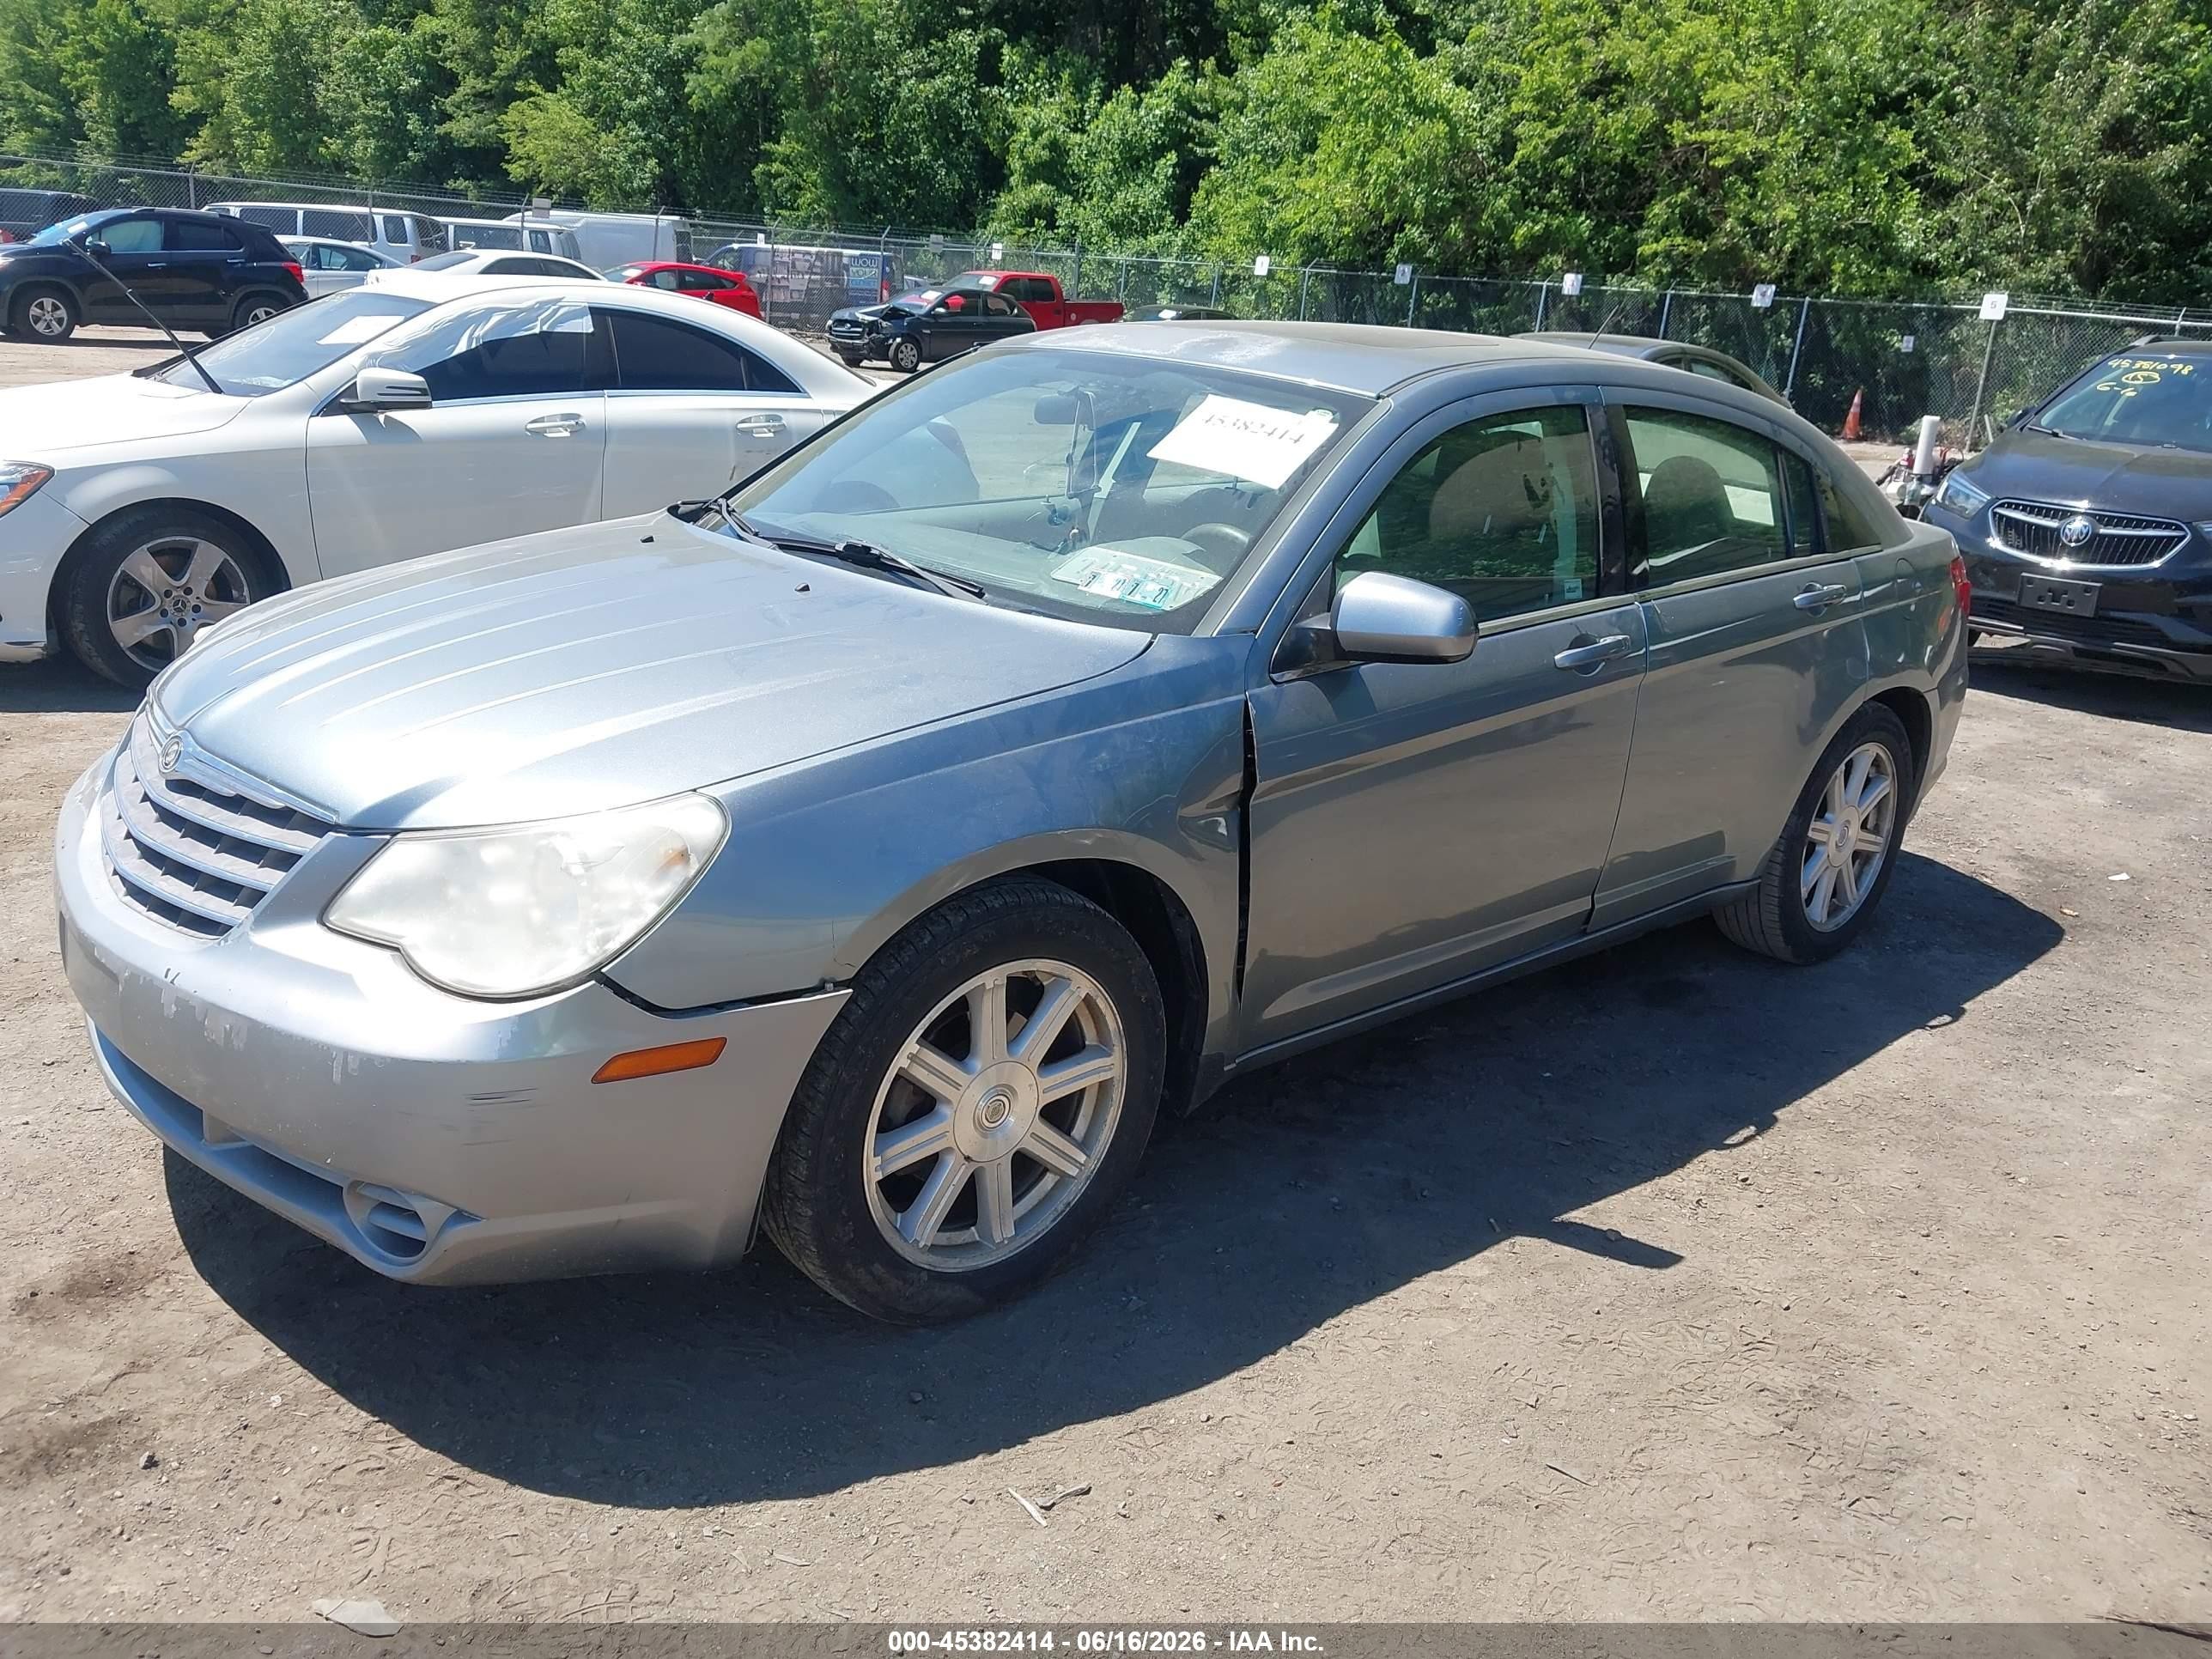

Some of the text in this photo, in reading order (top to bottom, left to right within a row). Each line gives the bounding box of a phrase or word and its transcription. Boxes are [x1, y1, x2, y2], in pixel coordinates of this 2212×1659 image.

[851, 257, 878, 268] WOW
[1990, 301, 1997, 309] 5
[1127, 582, 1170, 604] 7 27
